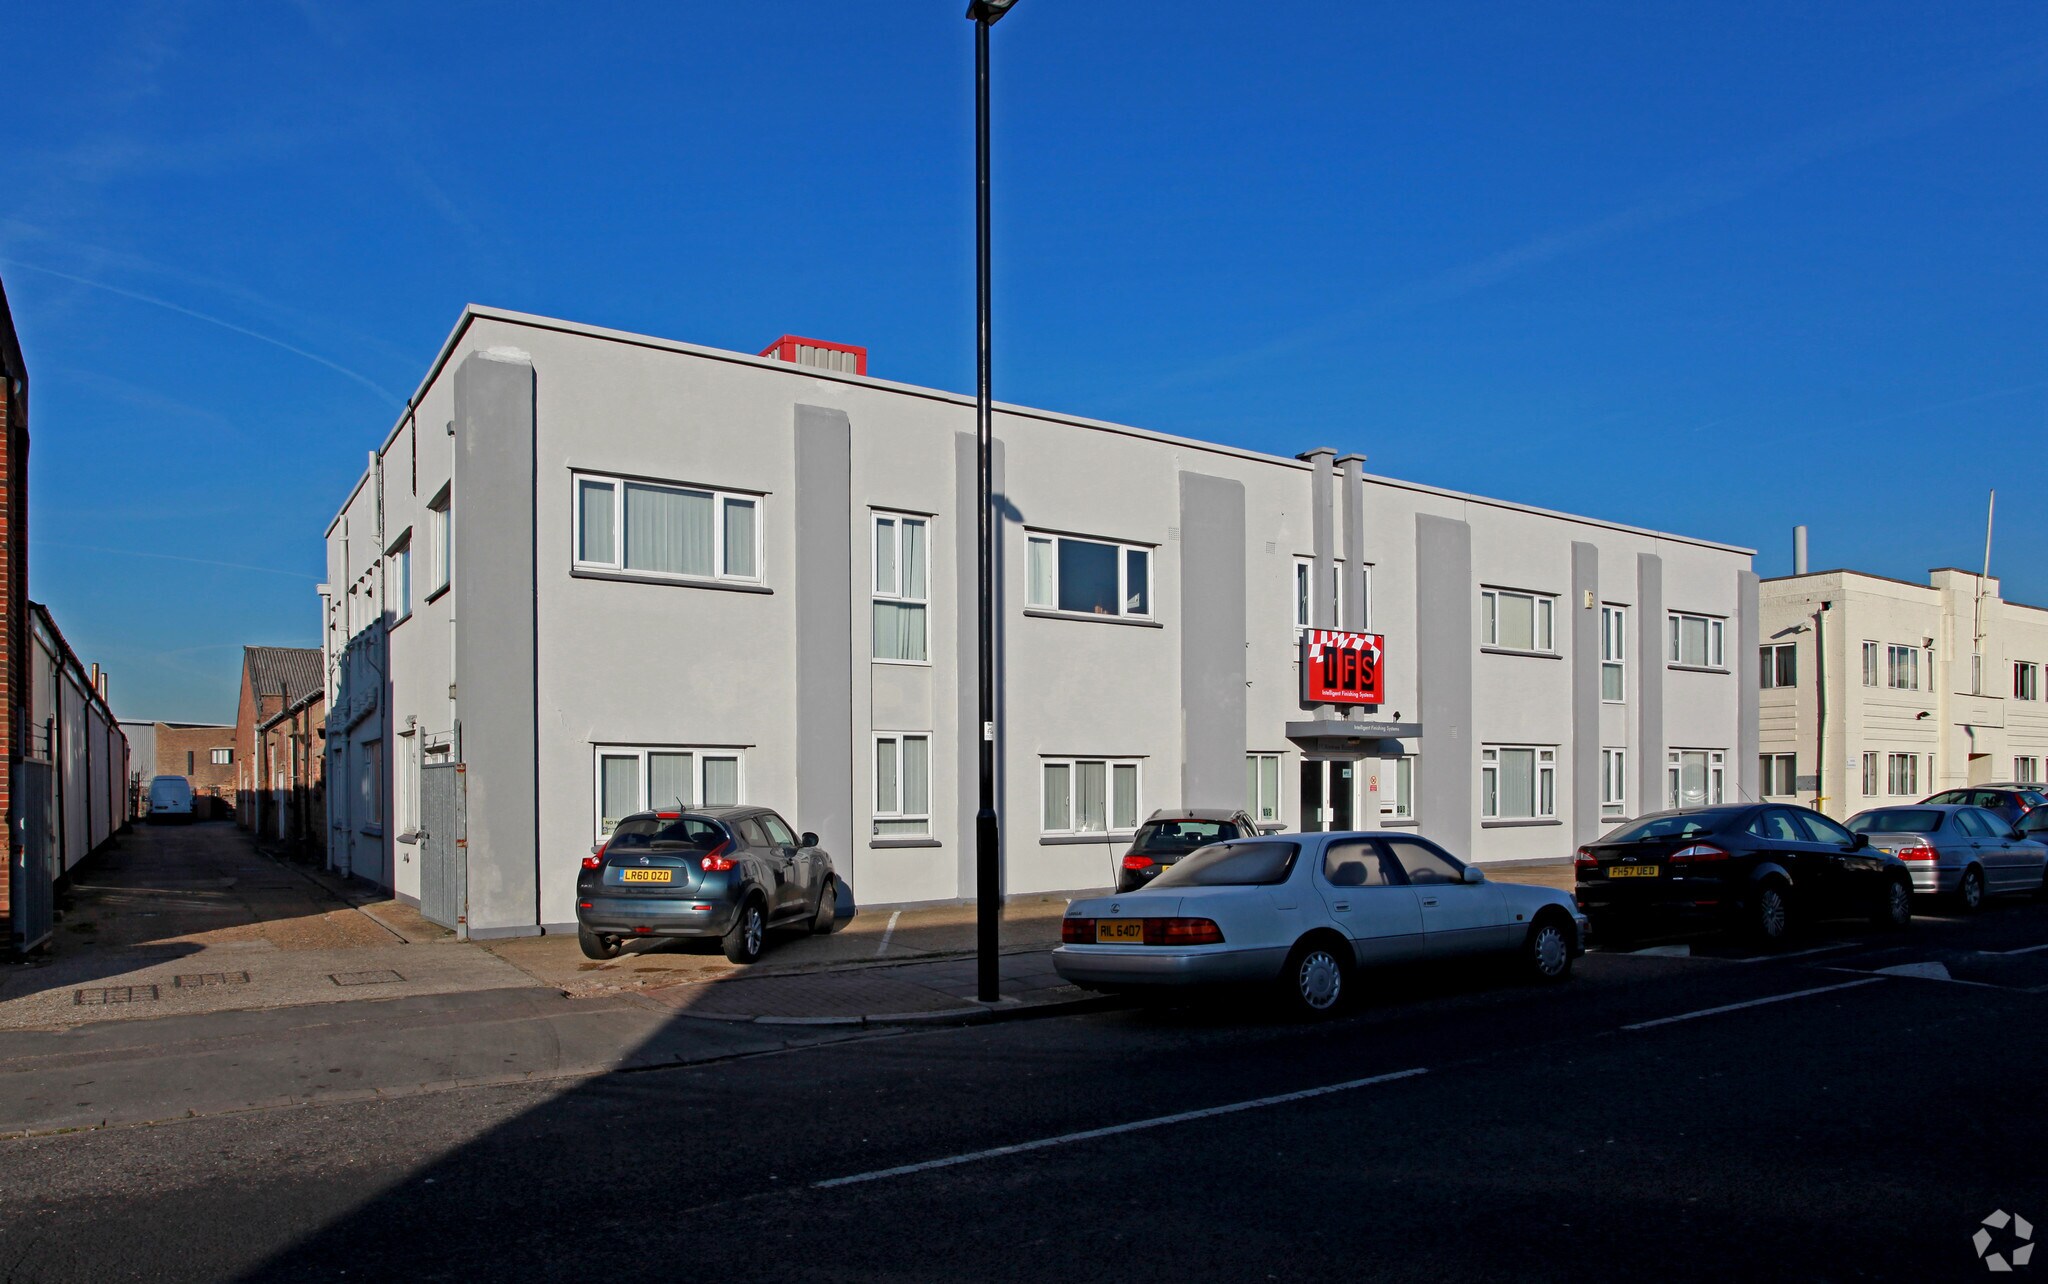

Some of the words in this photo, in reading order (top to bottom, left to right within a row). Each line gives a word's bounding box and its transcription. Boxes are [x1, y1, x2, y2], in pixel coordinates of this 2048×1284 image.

[1325, 649, 1374, 689] IFS
[1342, 690, 1358, 698] Finishing
[625, 871, 649, 880] LR60
[651, 871, 670, 880] OZD
[1612, 867, 1635, 876] FH57
[1636, 866, 1655, 875] UED
[1101, 925, 1114, 937] RIL
[1117, 925, 1141, 937] 6407
